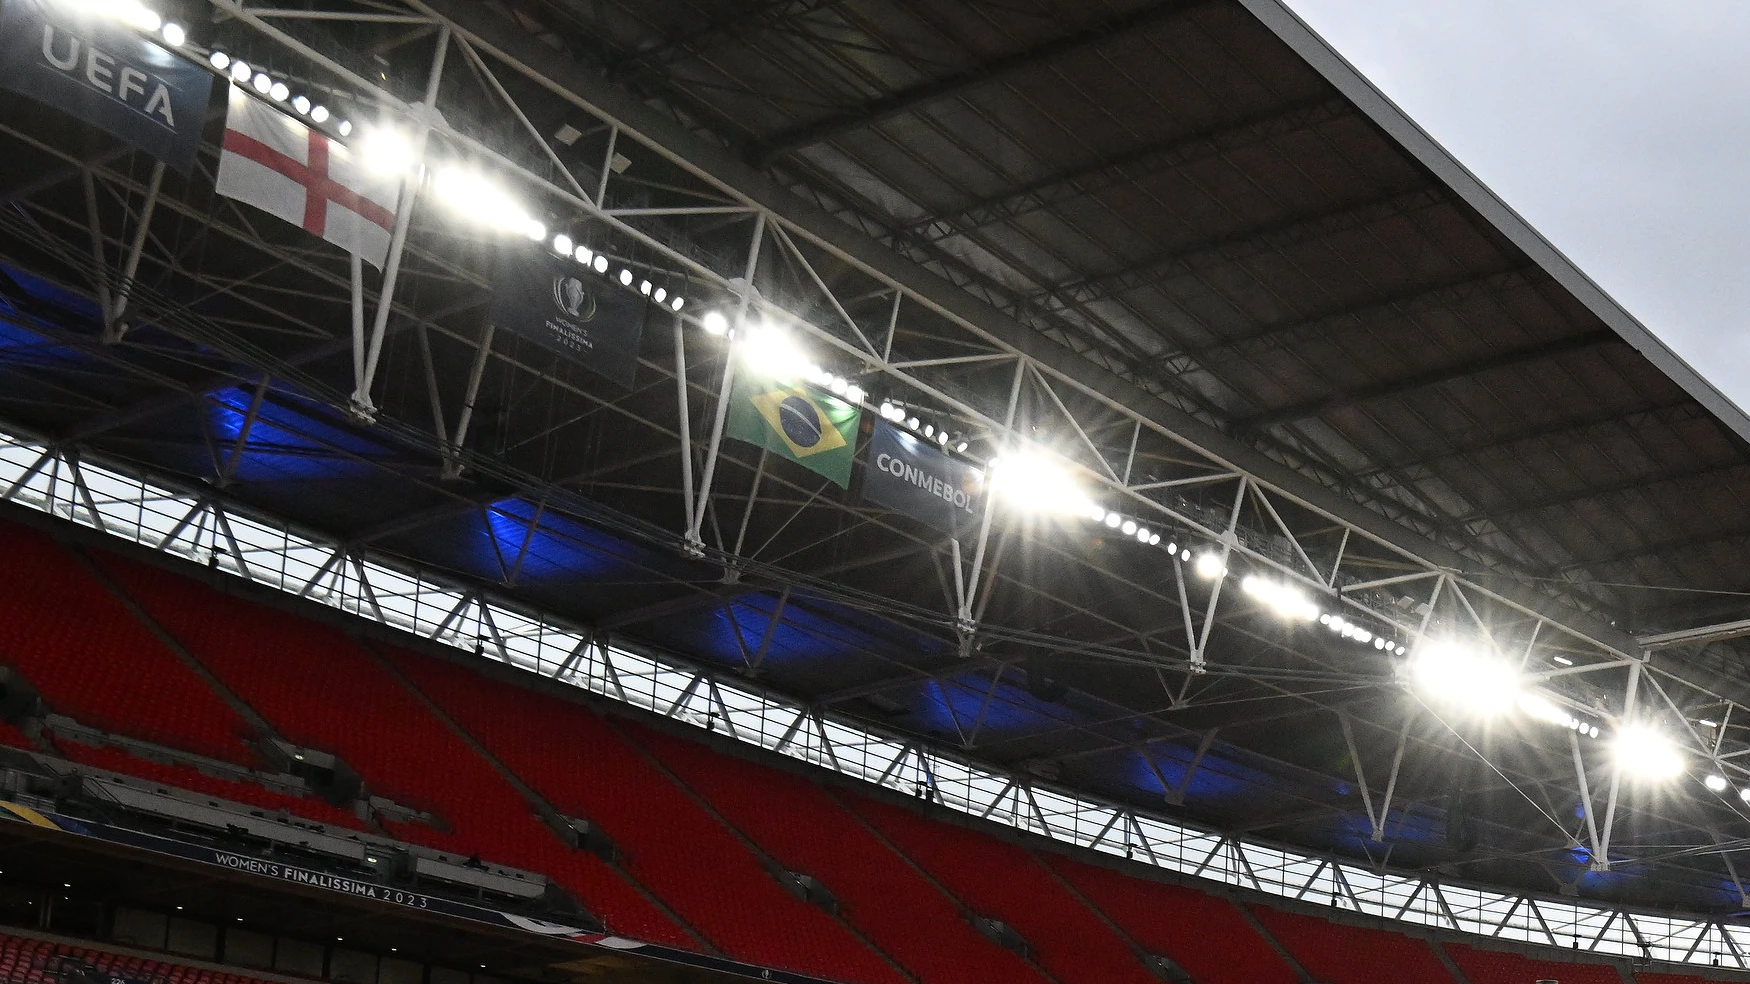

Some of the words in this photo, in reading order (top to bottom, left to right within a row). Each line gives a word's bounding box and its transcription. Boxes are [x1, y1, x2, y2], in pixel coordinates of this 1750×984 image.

[41, 24, 175, 128] UEFA
[545, 320, 593, 349] FINALISSIMA
[555, 316, 588, 337] WOMEN'S
[876, 453, 973, 514] CONMEBOL
[215, 852, 279, 876] WOMEN'S
[284, 867, 376, 898] FINALISSIMA
[383, 889, 427, 908] 2023
